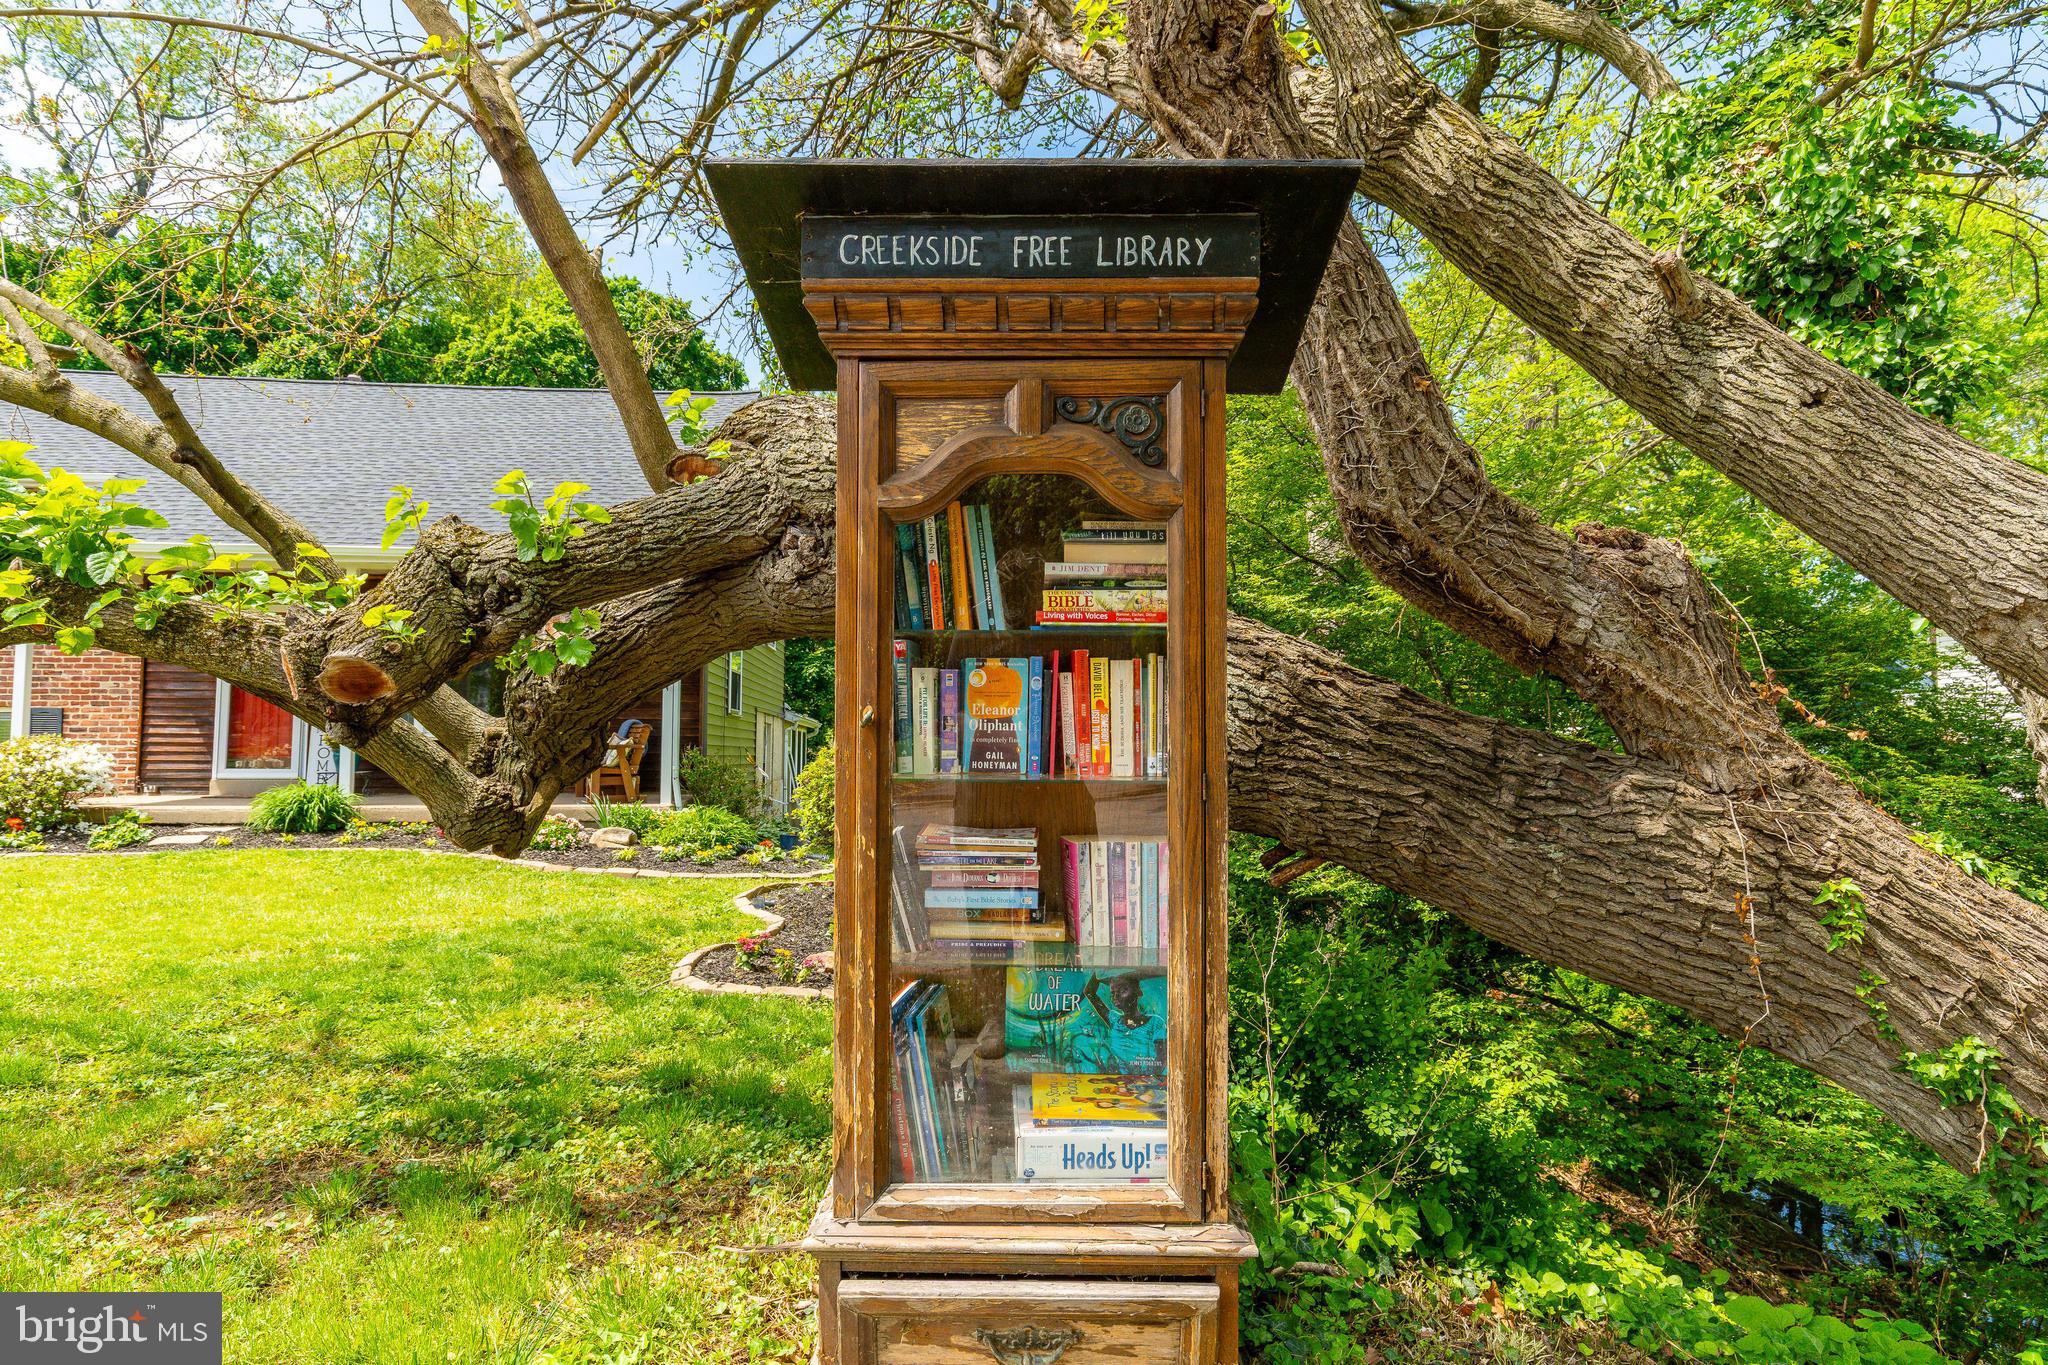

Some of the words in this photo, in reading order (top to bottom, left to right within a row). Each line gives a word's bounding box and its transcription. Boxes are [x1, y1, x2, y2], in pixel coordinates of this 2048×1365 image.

[839, 234, 984, 267] CREEKSIDE
[1012, 236, 1073, 267] FREE
[1096, 236, 1213, 267] LIBRARY
[1122, 531, 1140, 541] you
[928, 543, 935, 554] Ng
[1047, 595, 1094, 608] BIBLE
[1043, 612, 1065, 620] Living
[1085, 612, 1108, 620] Voices
[895, 643, 907, 651] YA
[896, 663, 907, 682] KIDNEY
[1093, 662, 1102, 681] DAVID
[1093, 683, 1103, 699] BELL
[972, 704, 1021, 715] Eleanor
[1062, 686, 1070, 718] KRISTAN
[1091, 709, 1100, 724] USED
[969, 718, 1023, 734] Oliphant
[1100, 713, 1109, 742] SOMEBODY
[976, 736, 1008, 745] completely
[1063, 719, 1071, 751] HIGGINS
[1092, 733, 1100, 751] KNOW
[985, 752, 1004, 760] GAIL
[972, 761, 1017, 770] HONEYMAN
[983, 857, 998, 865] LAKE
[957, 909, 981, 918] BOX
[1048, 975, 1062, 990] OF
[1029, 992, 1081, 1011] WATER
[895, 1098, 906, 1139] Christmas
[1062, 1143, 1118, 1170] Heads
[1121, 1142, 1151, 1174] Up!
